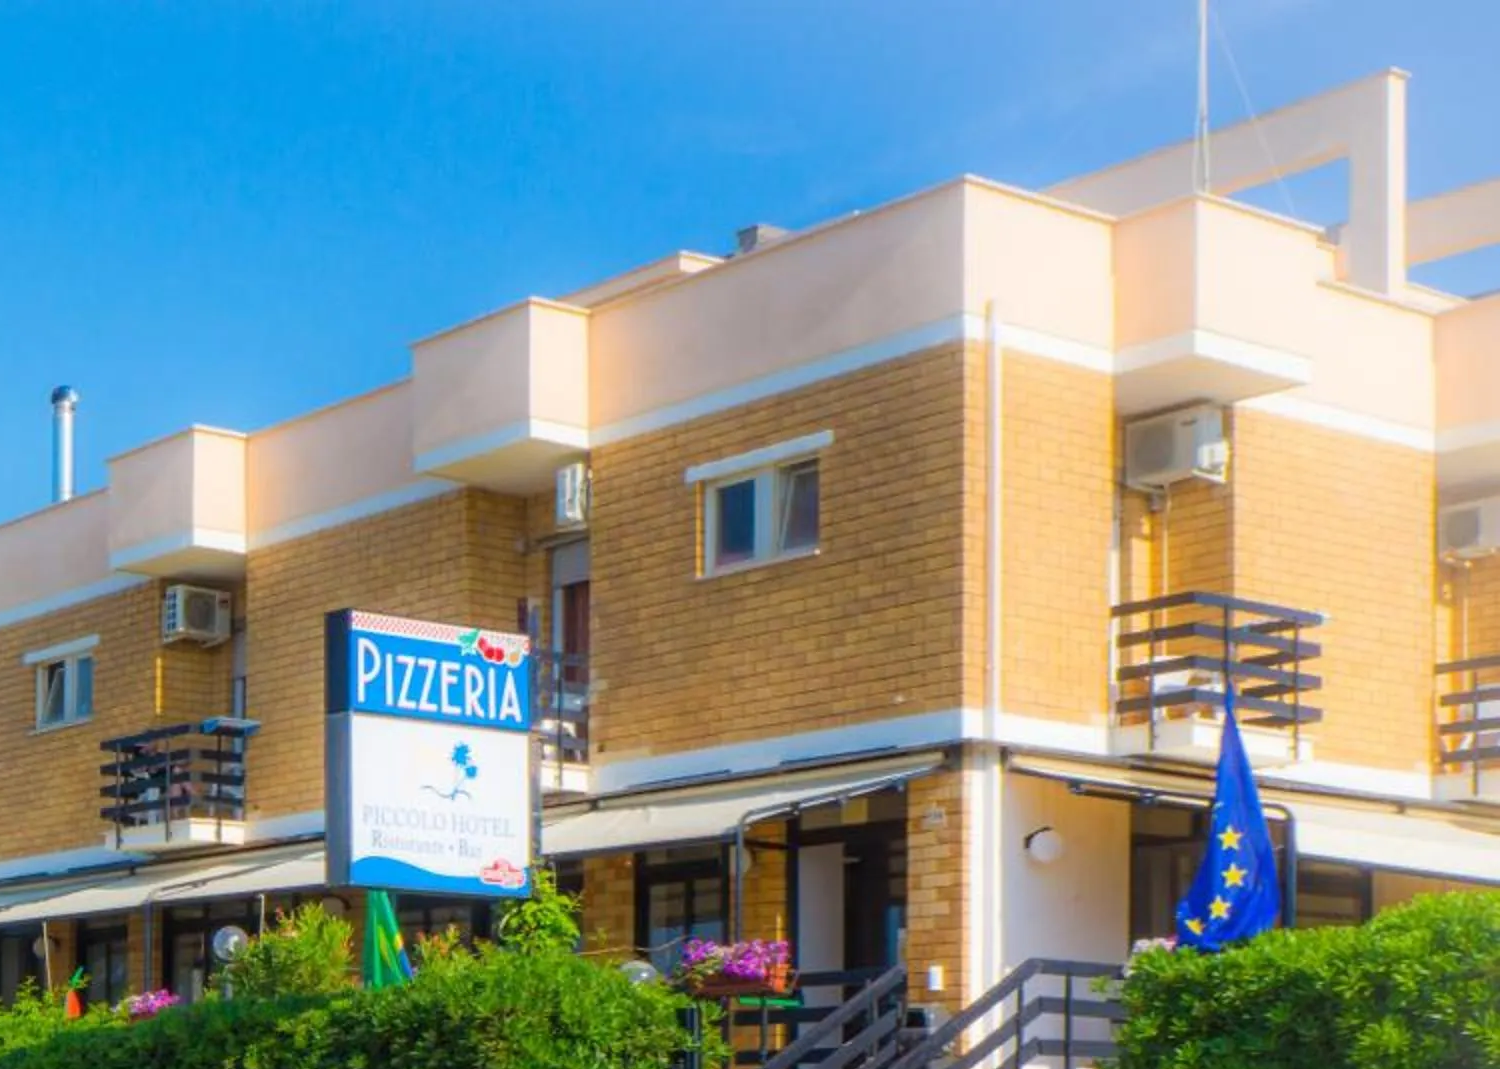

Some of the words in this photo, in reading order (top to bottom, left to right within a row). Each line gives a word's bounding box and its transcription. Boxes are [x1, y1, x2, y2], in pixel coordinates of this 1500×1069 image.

[356, 637, 523, 723] PIZZERIA
[362, 803, 447, 831] PICCOLO
[451, 812, 516, 837] HOTEL
